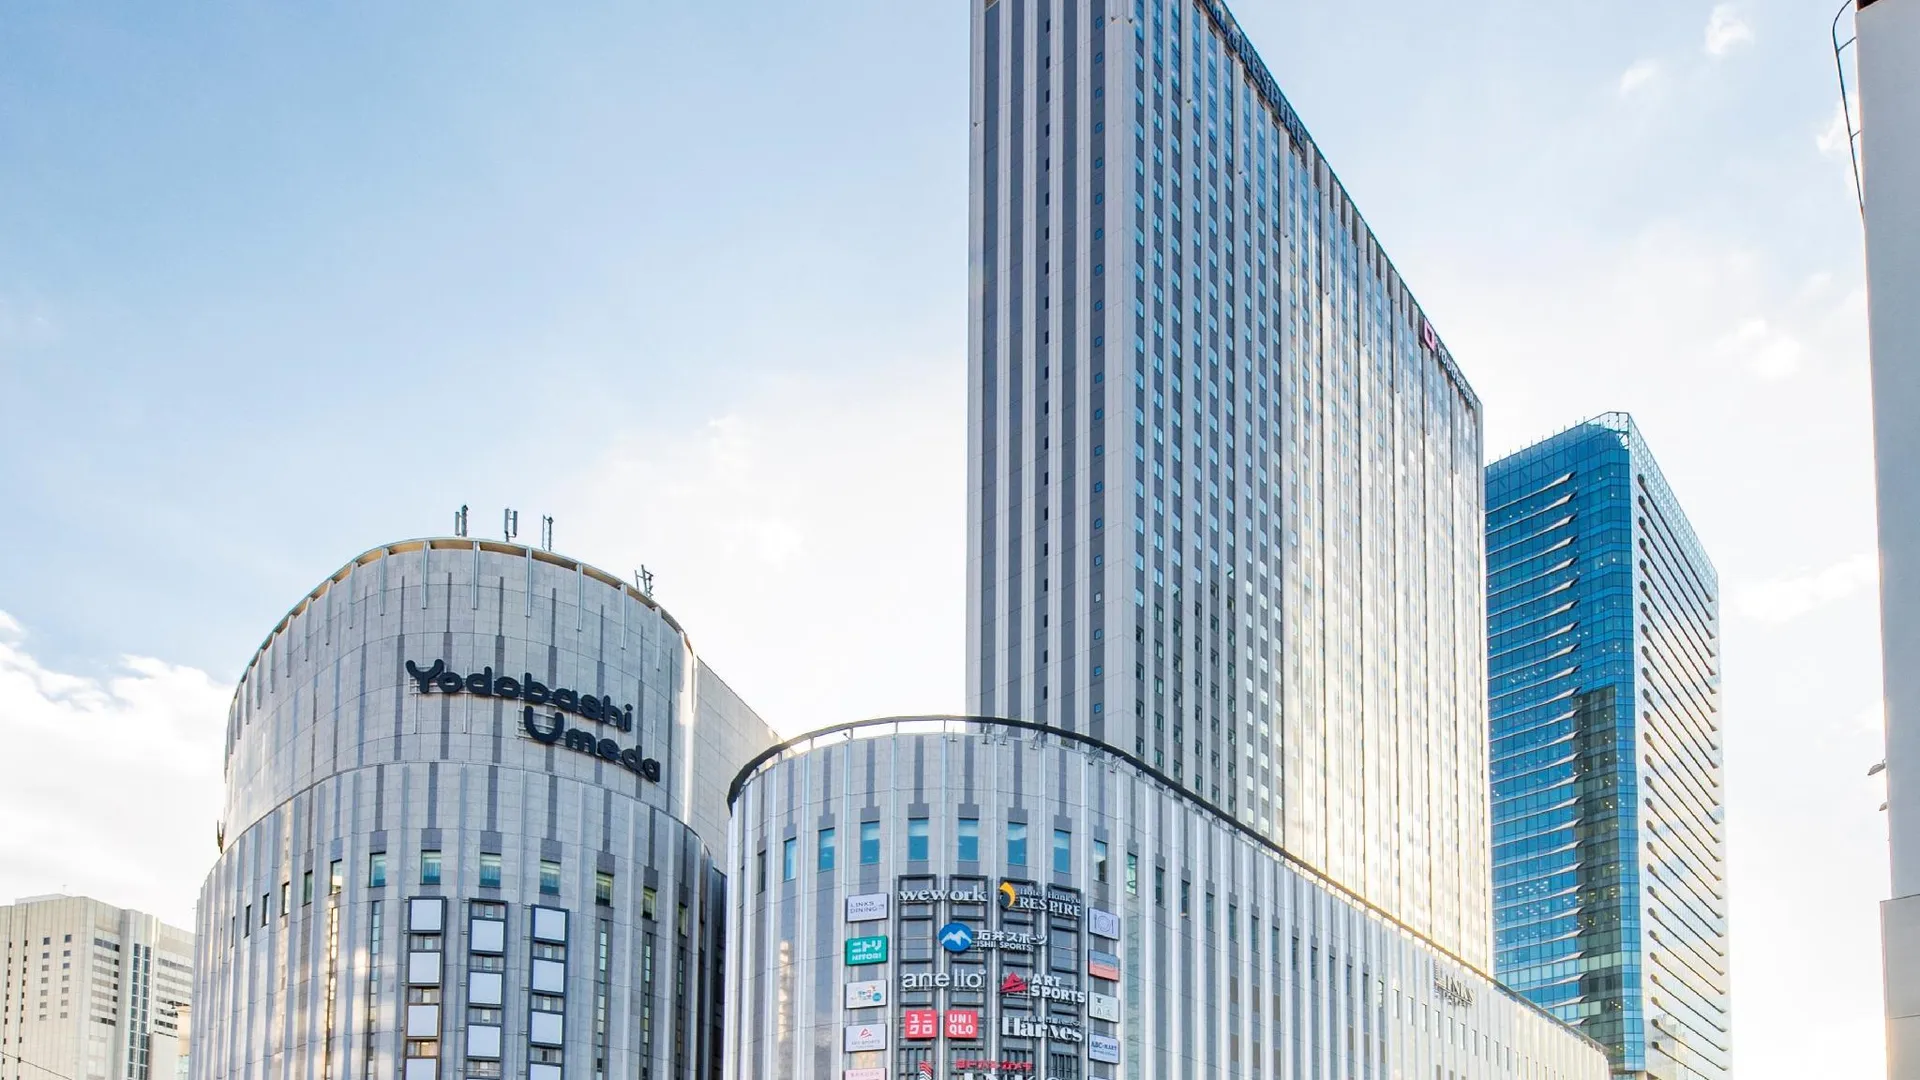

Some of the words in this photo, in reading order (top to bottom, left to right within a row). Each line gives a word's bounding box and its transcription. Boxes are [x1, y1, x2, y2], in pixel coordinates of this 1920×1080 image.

[406, 659, 633, 732] Yodobashi
[524, 705, 661, 783] Umeda
[1047, 891, 1080, 904] Hankyu
[1020, 897, 1081, 916] RESPIRE
[977, 929, 1047, 945] 石井スポーツ
[852, 940, 882, 953] ニトリ
[976, 940, 996, 948] ISHII
[1000, 941, 1033, 952] SPORTS
[852, 953, 882, 961] NITORI
[903, 969, 981, 988] anello
[1032, 973, 1061, 987] ART
[1031, 985, 1085, 1003] SPORTS
[1002, 1016, 1083, 1042] Harves
